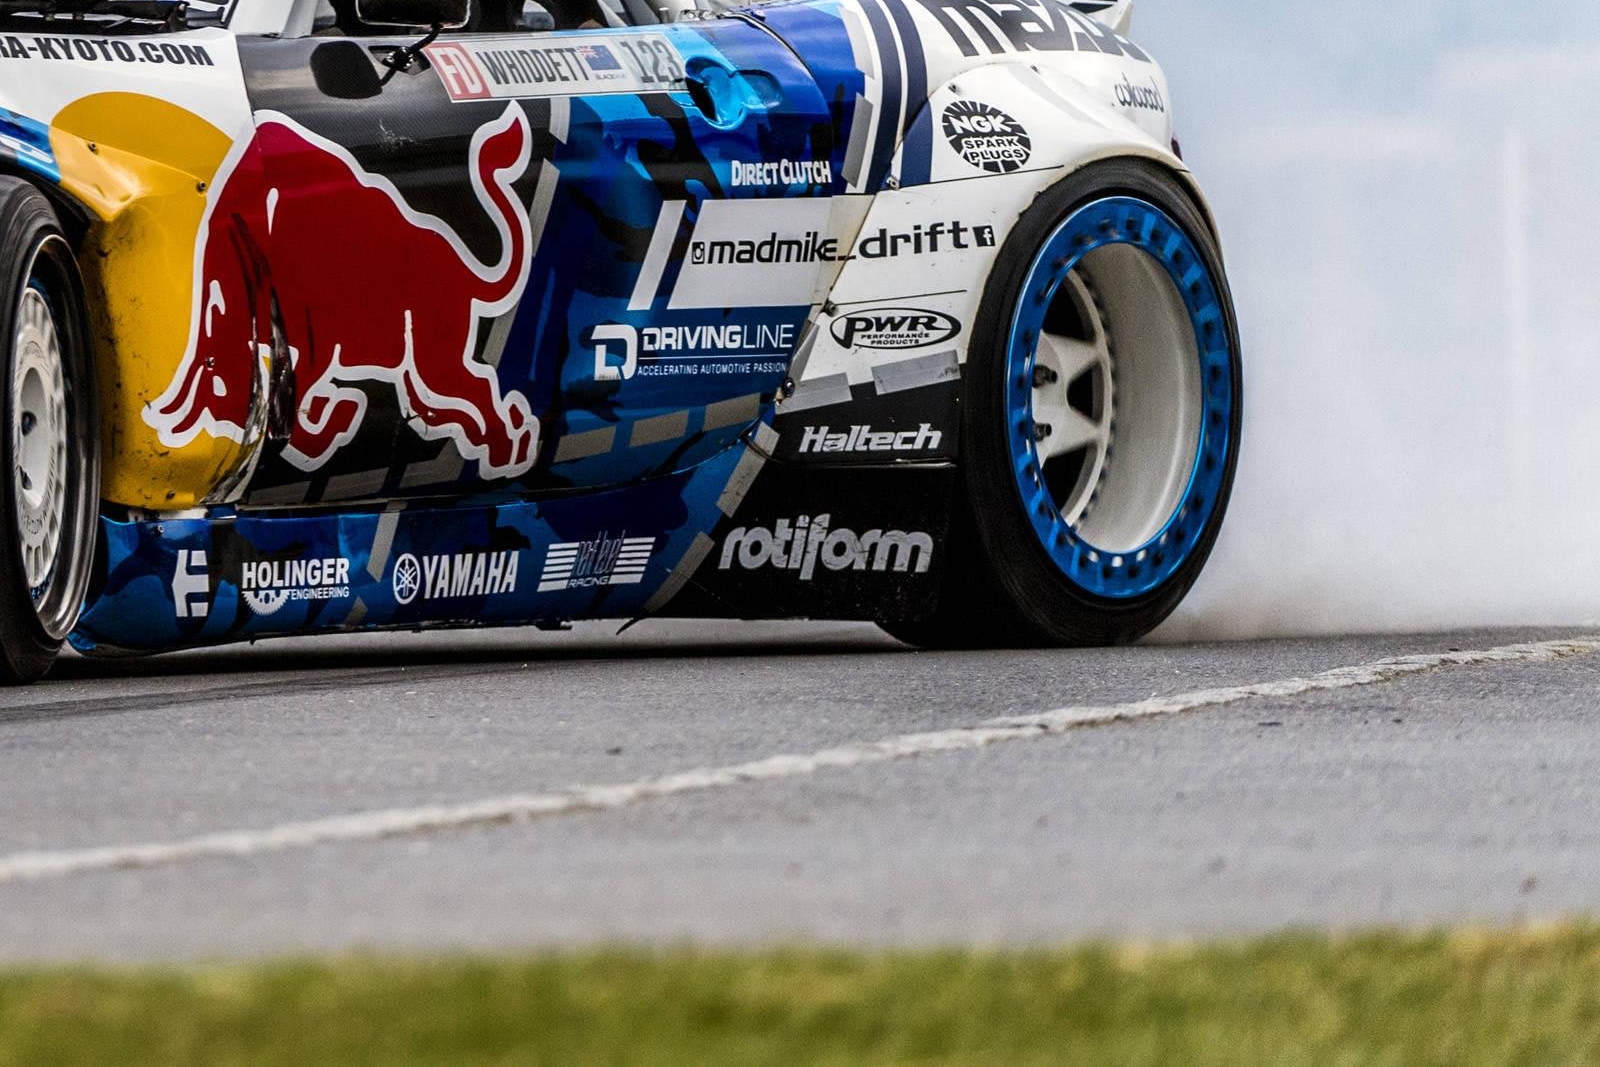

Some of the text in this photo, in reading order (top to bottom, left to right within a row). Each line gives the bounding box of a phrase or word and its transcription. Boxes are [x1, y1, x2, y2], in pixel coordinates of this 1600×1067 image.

[475, 46, 590, 85] WHIDDETT
[620, 39, 683, 84] 123
[949, 114, 1013, 135] NGK
[963, 137, 1019, 150] SPARK
[968, 147, 1026, 162] PLUGS
[731, 158, 832, 187] DIRECT CLUTCH
[843, 316, 944, 349] PWR
[860, 332, 930, 340] PERFORMANCE
[870, 338, 920, 346] PRODUCTS
[638, 362, 788, 376] ACCELERATING AUTOMOTIVE PASSION
[798, 423, 943, 453] Haltech
[717, 513, 934, 581] rotiform
[242, 557, 350, 589] HOLINGER
[423, 550, 520, 600] YAMAHA
[290, 586, 350, 601] ENGINEERING
